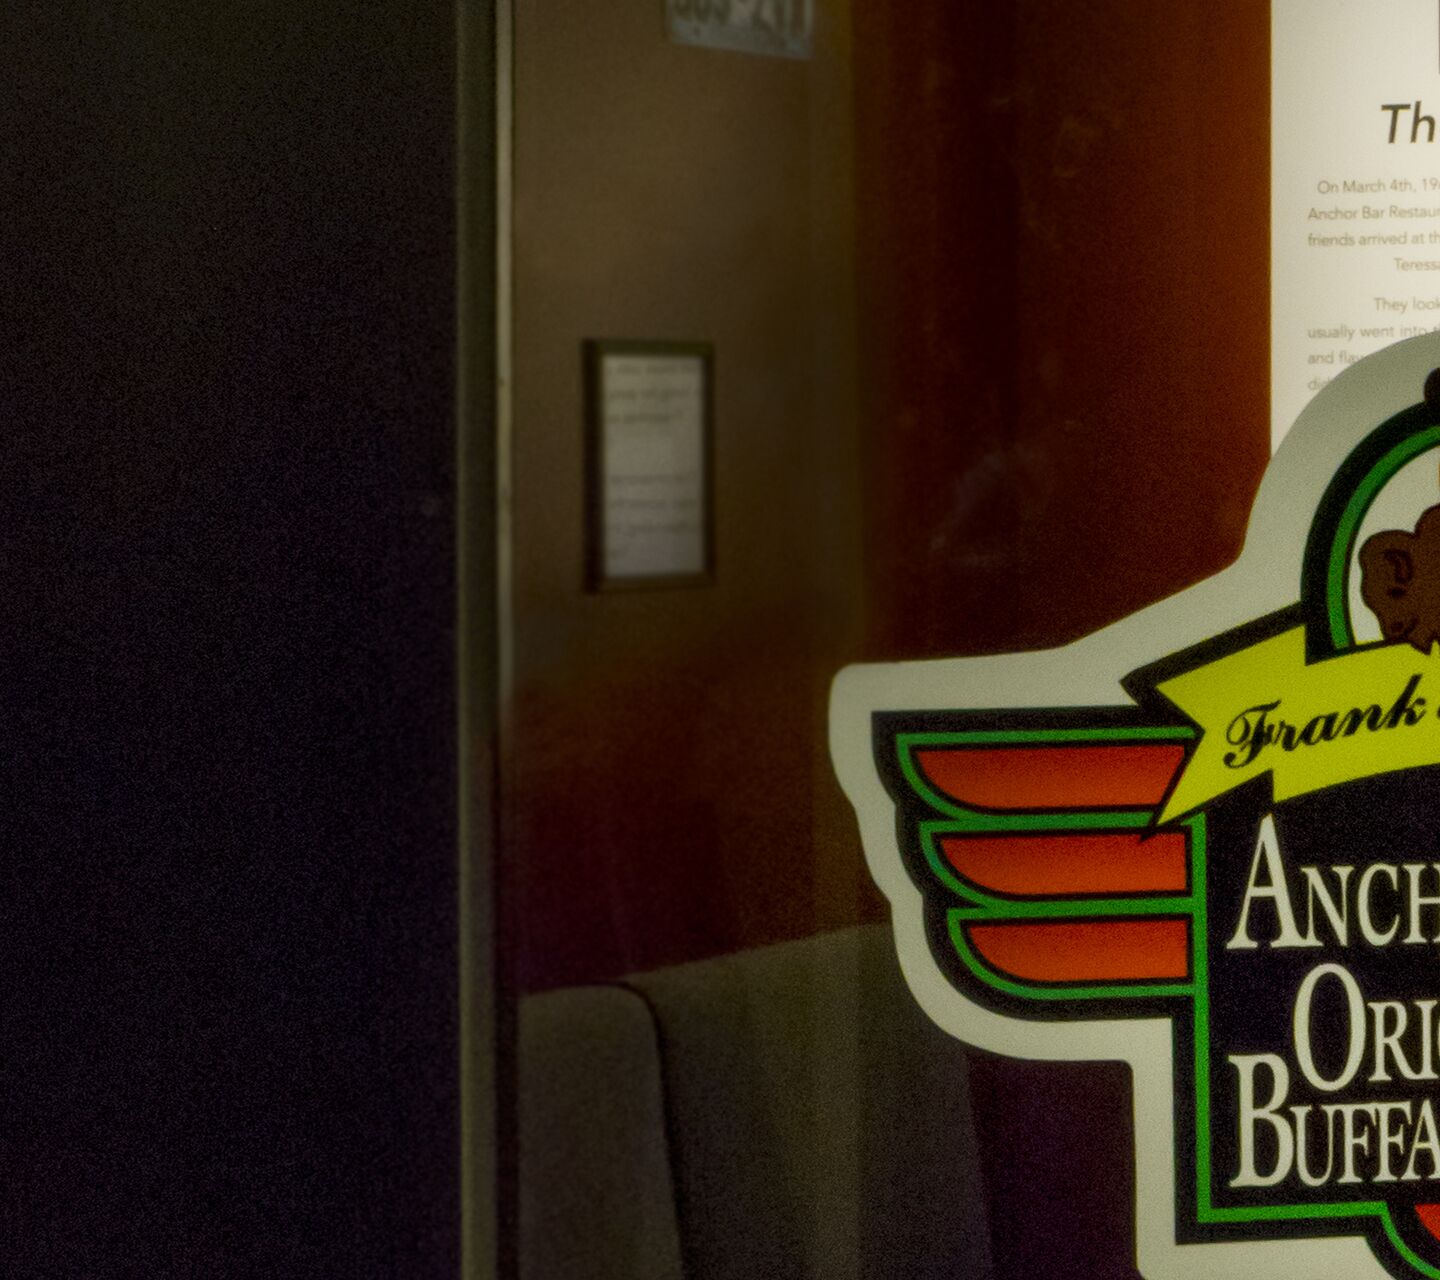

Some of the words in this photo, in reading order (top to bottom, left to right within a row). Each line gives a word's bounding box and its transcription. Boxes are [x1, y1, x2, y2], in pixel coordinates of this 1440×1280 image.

[1317, 181, 1339, 194] On
[1343, 179, 1386, 193] March
[1390, 178, 1417, 193] 4th,
[1308, 207, 1357, 220] Anchor
[1362, 205, 1384, 219] Bar
[1308, 232, 1355, 247] friends
[1359, 232, 1407, 246] arrived
[1411, 232, 1424, 245] at
[1374, 297, 1408, 314] They
[1308, 325, 1355, 341] usually
[1360, 326, 1394, 338] went
[1308, 349, 1334, 364] and
[1223, 674, 1428, 768] Frank
